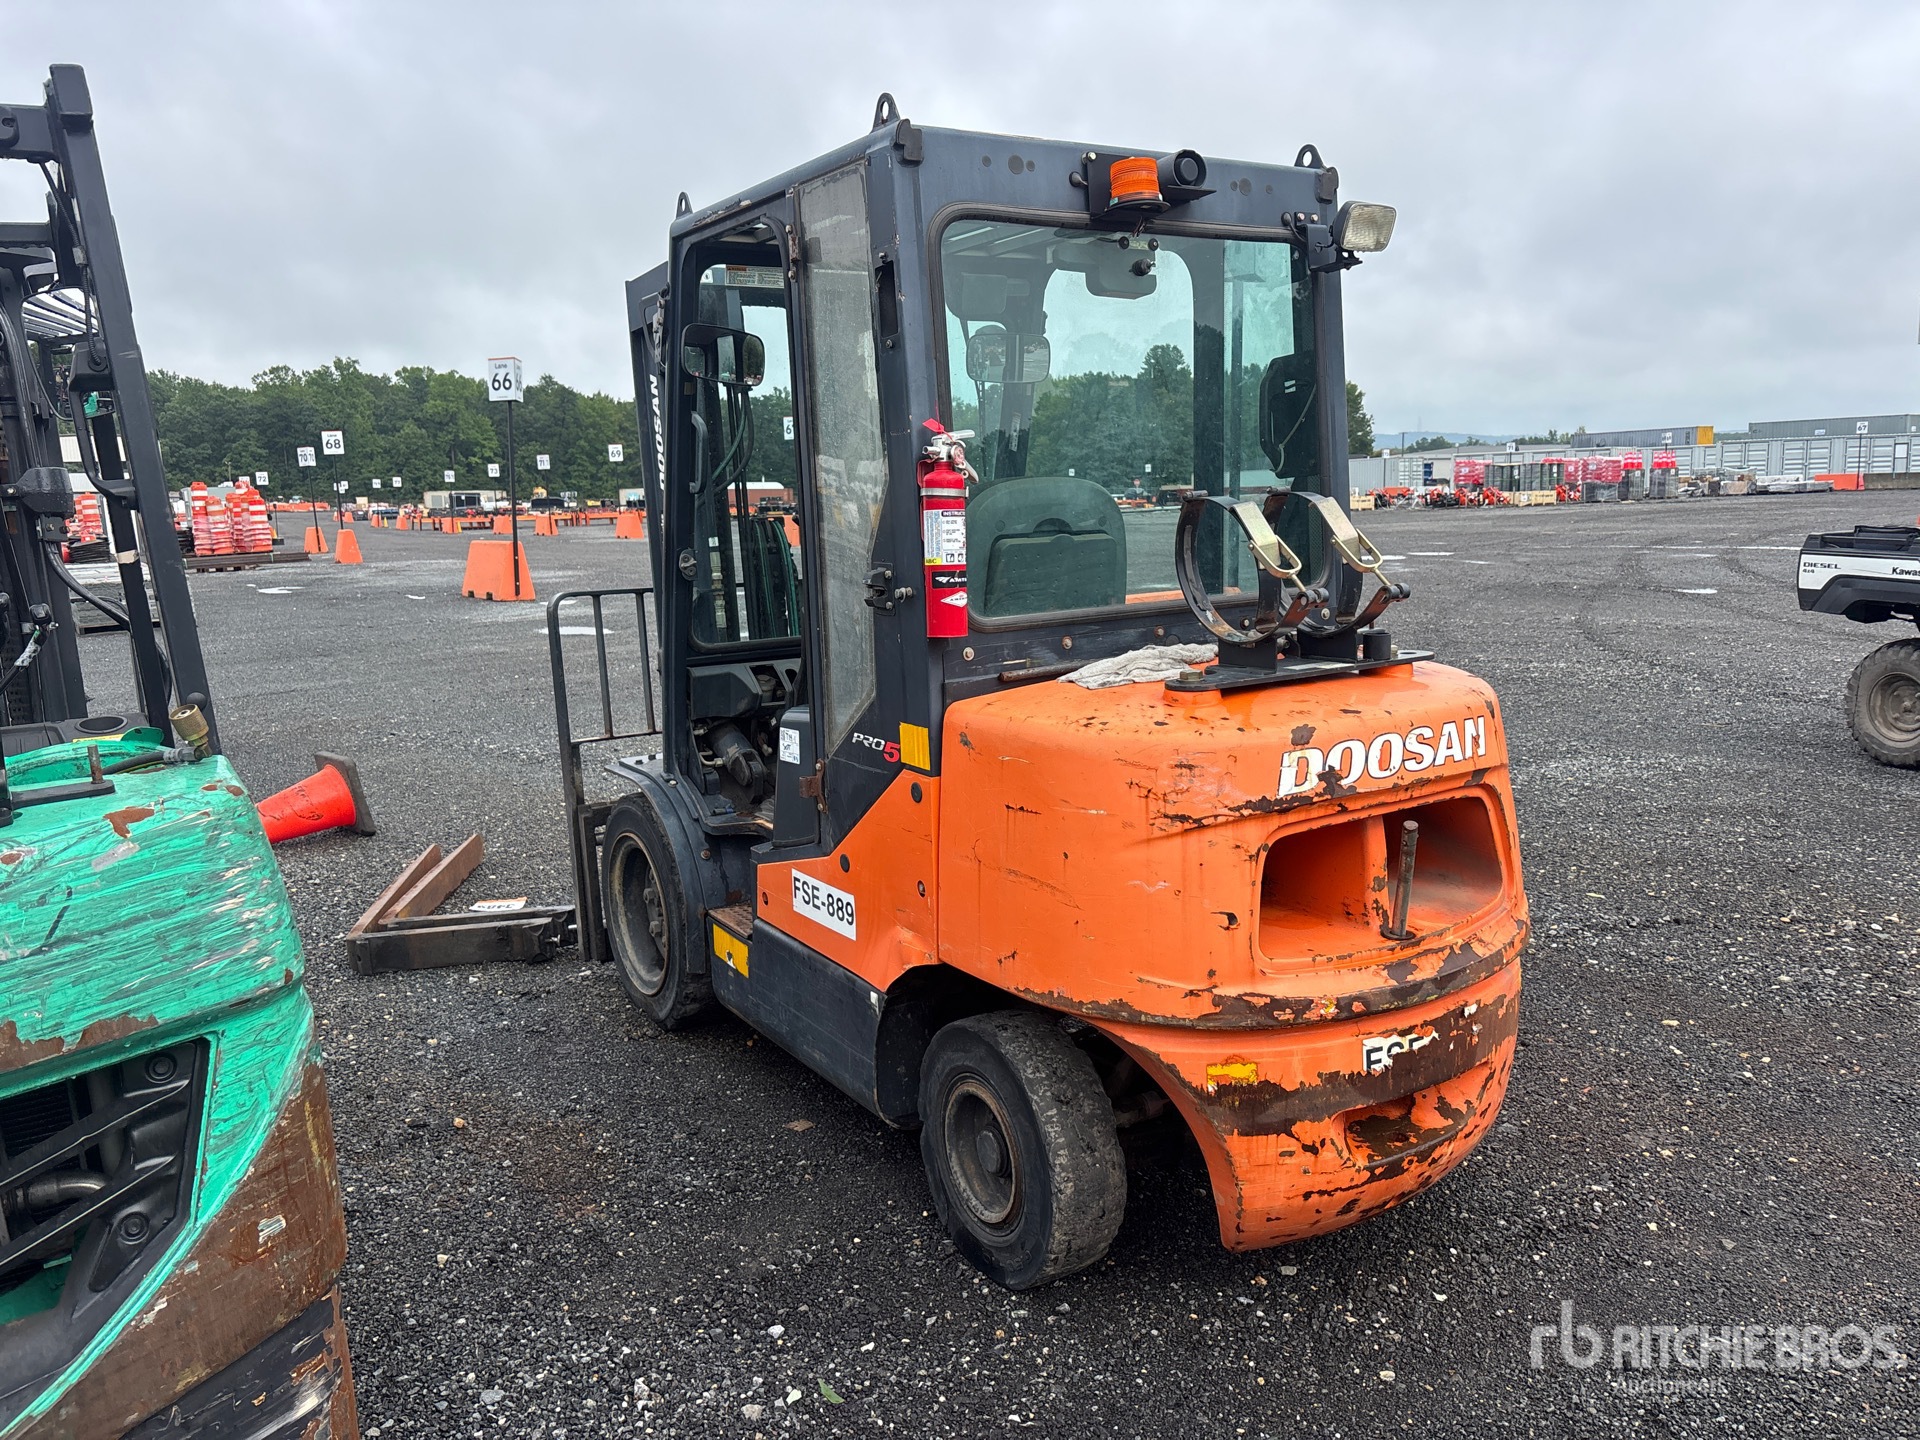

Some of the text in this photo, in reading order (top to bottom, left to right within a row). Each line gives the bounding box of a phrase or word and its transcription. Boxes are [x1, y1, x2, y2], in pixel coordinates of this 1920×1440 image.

[491, 372, 513, 392] 66
[649, 374, 665, 491] DOOSAN
[785, 424, 794, 435] 6
[1857, 424, 1867, 432] 67
[325, 438, 342, 450] 68
[299, 453, 308, 463] 70
[610, 449, 622, 458] 69
[1803, 561, 1842, 570] DIESEL
[1277, 715, 1487, 798] DOOSAN
[793, 876, 855, 926] FSE-889
